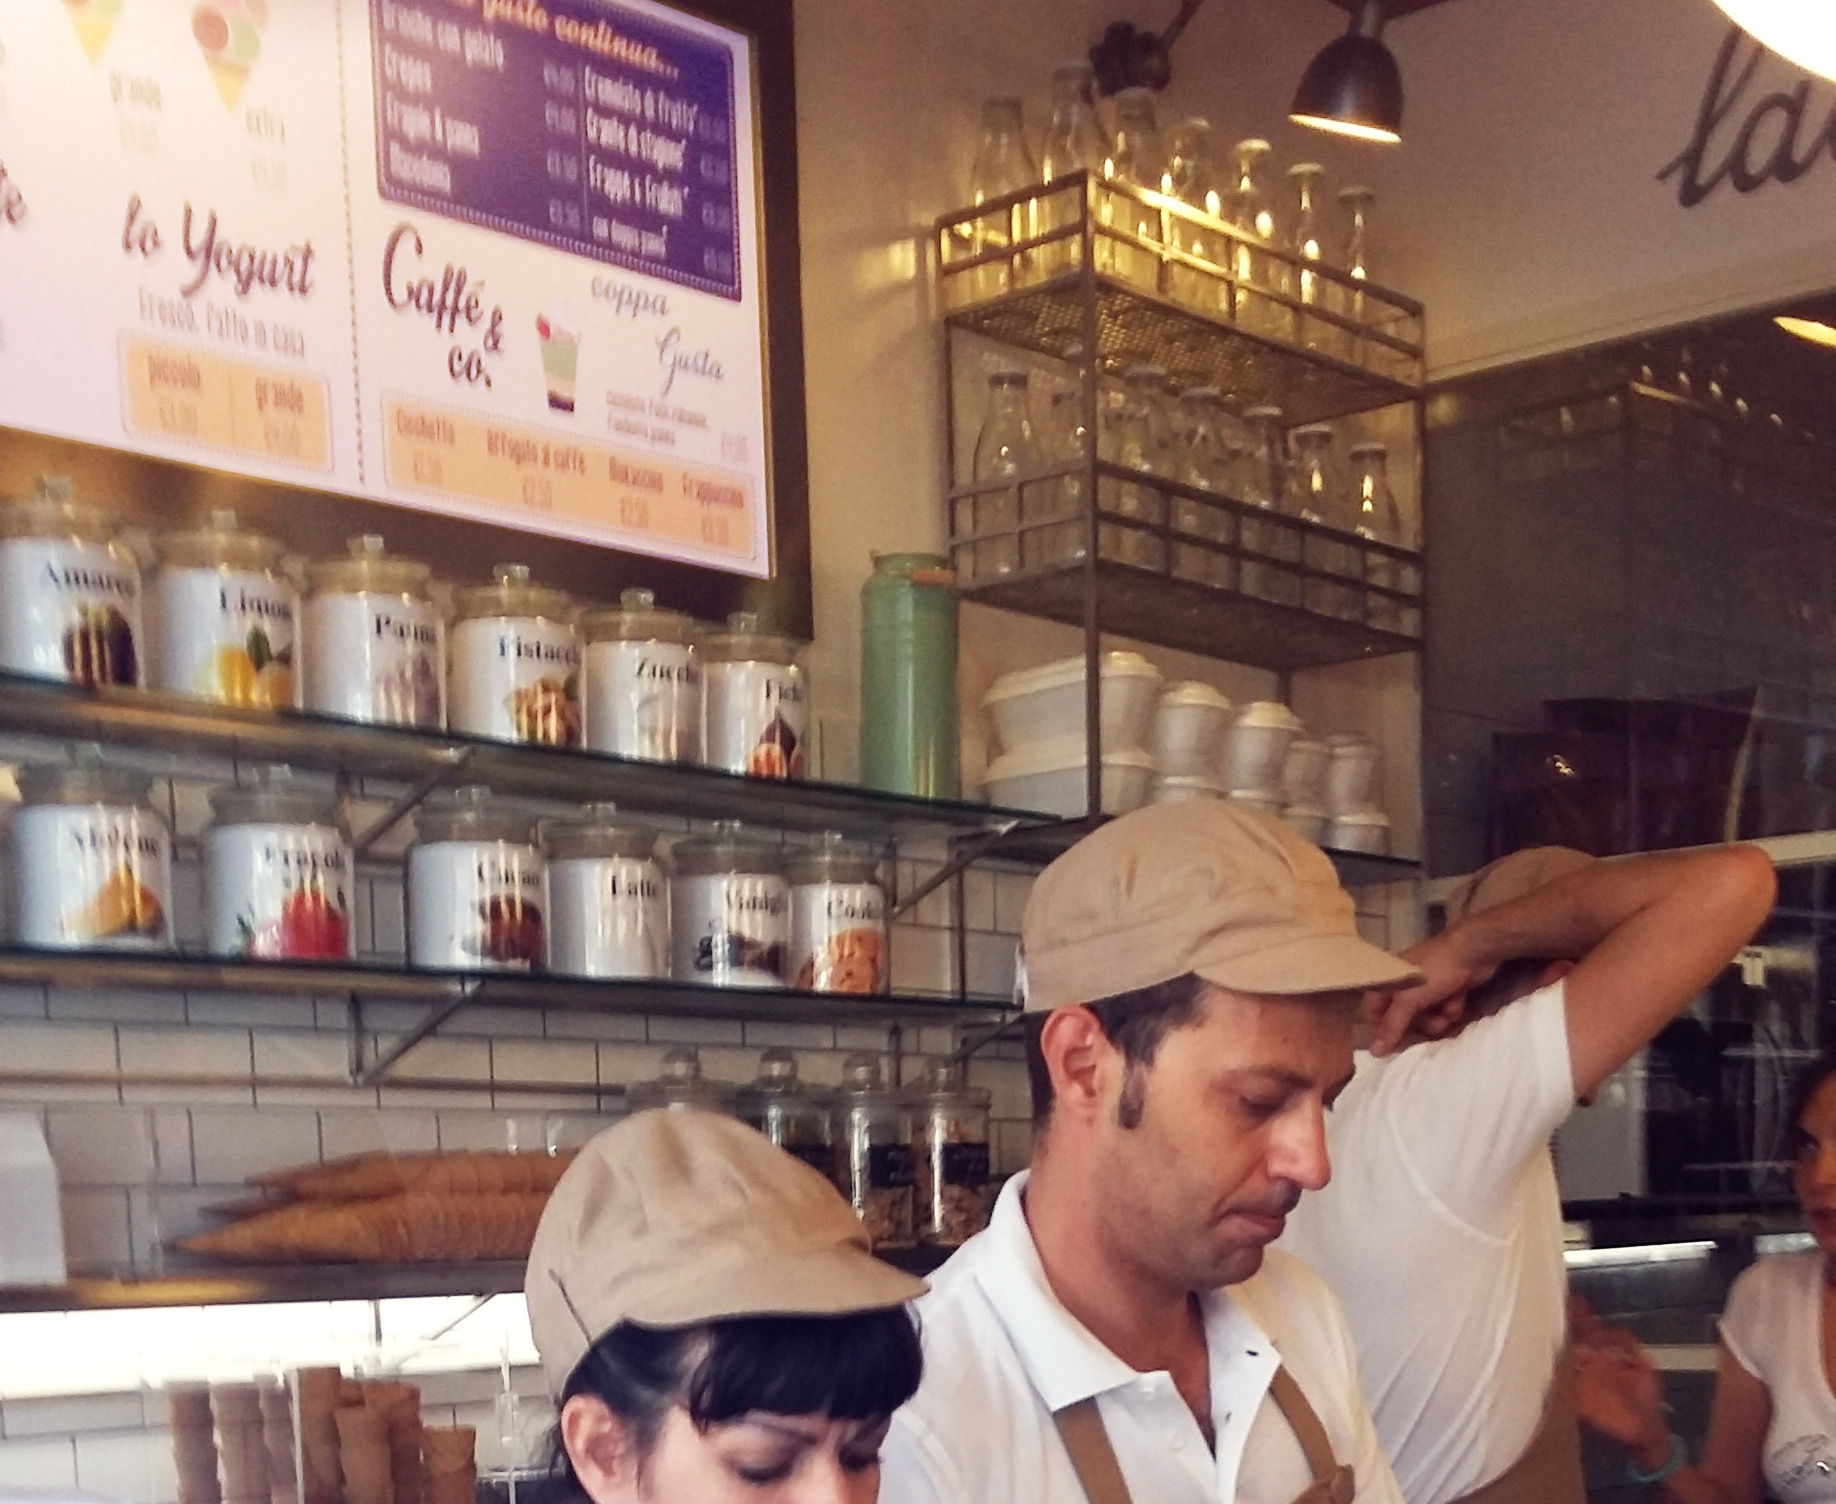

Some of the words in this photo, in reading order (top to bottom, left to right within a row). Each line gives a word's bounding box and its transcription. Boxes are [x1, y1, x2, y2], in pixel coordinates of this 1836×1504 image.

[1656, 25, 1836, 208] la
[120, 190, 164, 258] lo
[179, 199, 317, 298] Yogurt
[590, 276, 669, 317] coppa
[484, 304, 505, 355] &
[448, 344, 493, 389] co.
[656, 326, 724, 397] Gusta
